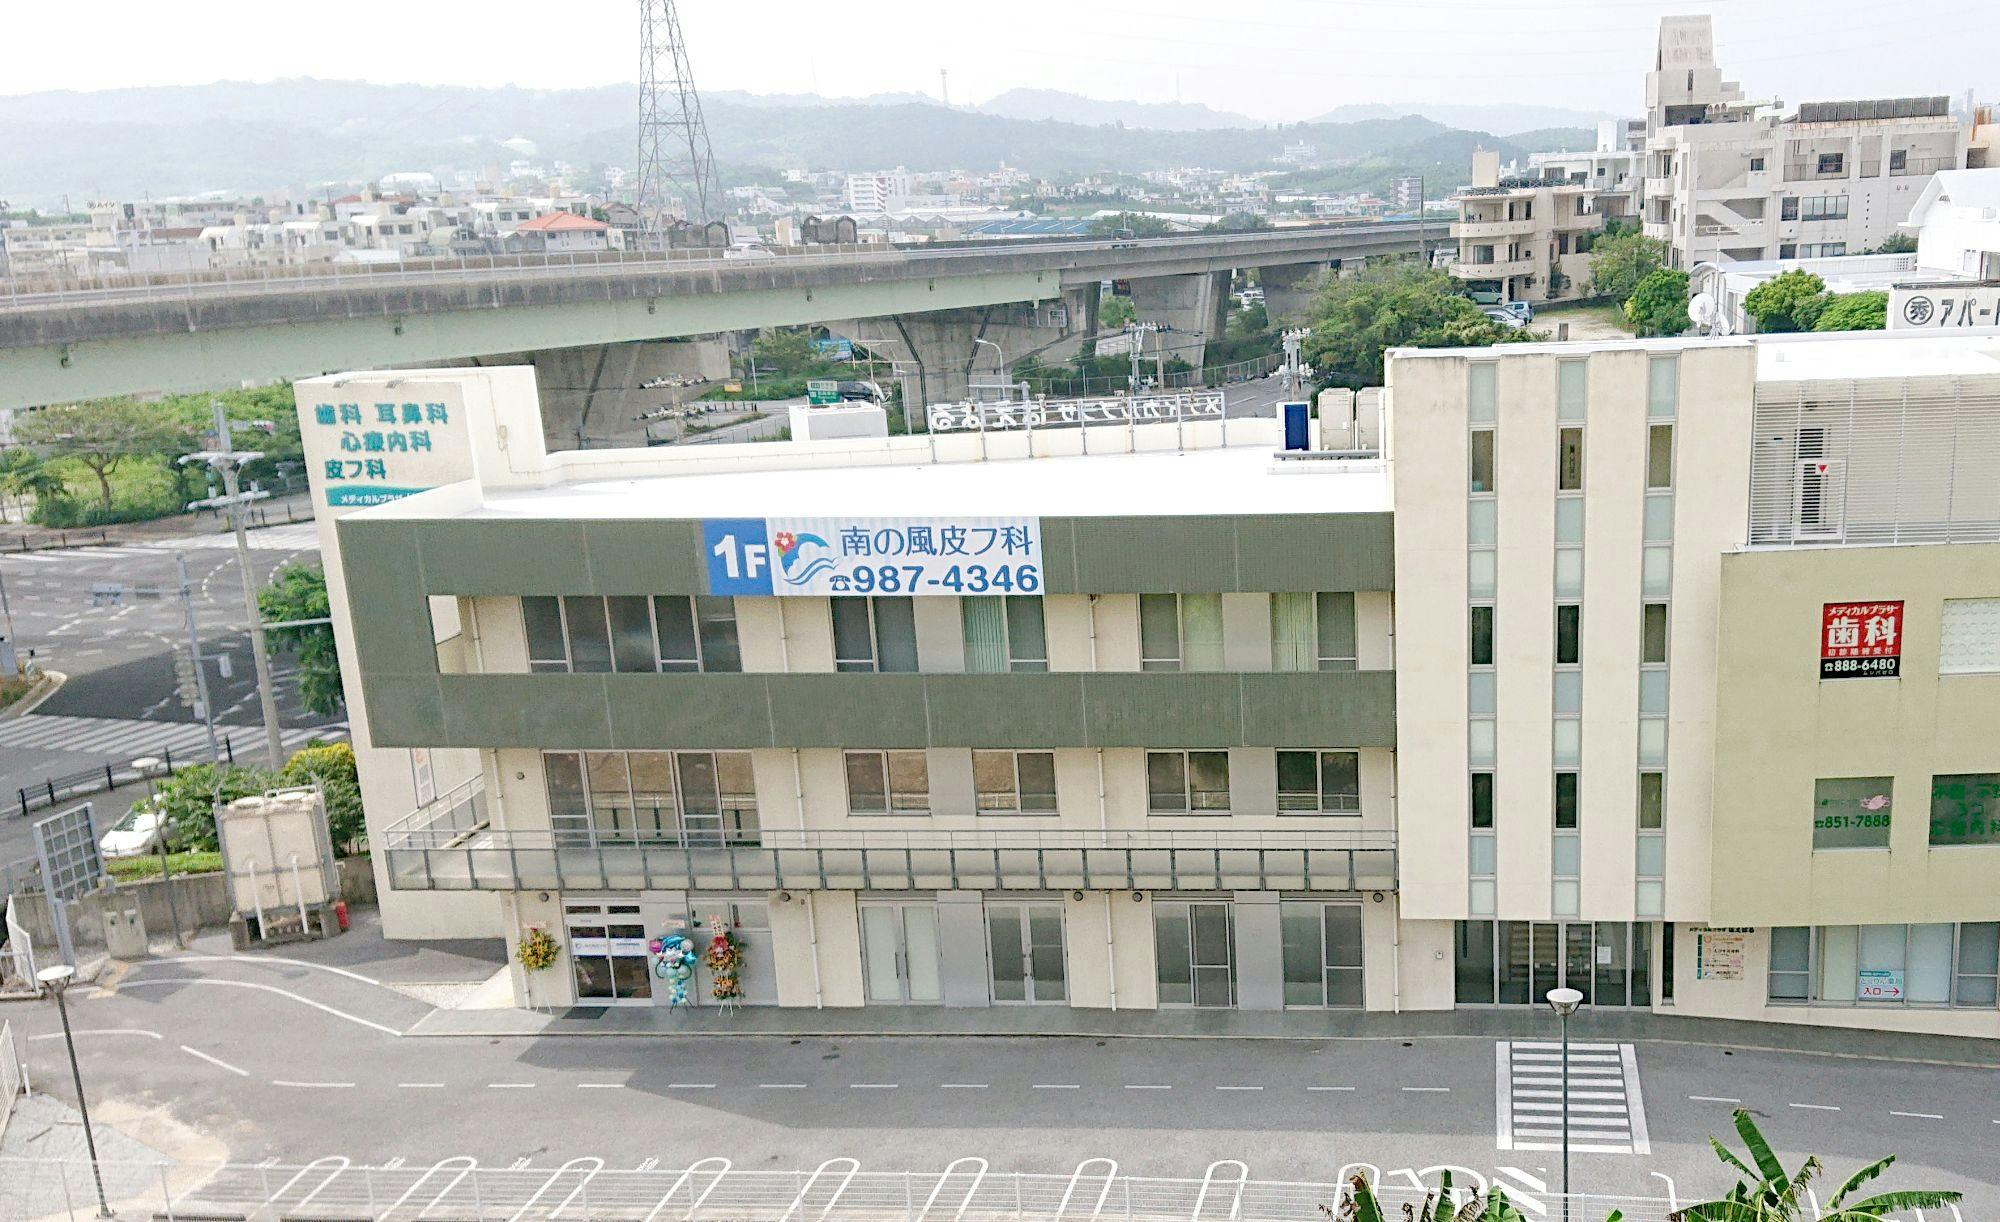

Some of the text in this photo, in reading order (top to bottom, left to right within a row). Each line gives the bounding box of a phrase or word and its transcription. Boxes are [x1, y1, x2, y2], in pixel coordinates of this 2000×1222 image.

[315, 402, 449, 425] 歯科 耳鼻科
[340, 430, 432, 452] 心療内科
[325, 459, 386, 480] 皮フ科
[840, 525, 1034, 557] 南の風皮フ科
[713, 534, 767, 580] 1F
[853, 564, 1039, 593] 987-4346
[1828, 604, 1899, 617] メディカルプラザ
[1827, 615, 1897, 648] 歯科
[1834, 659, 1895, 671] 888-6480
[1825, 815, 1891, 828] 851-7888
[1863, 987, 1882, 995] 入口
